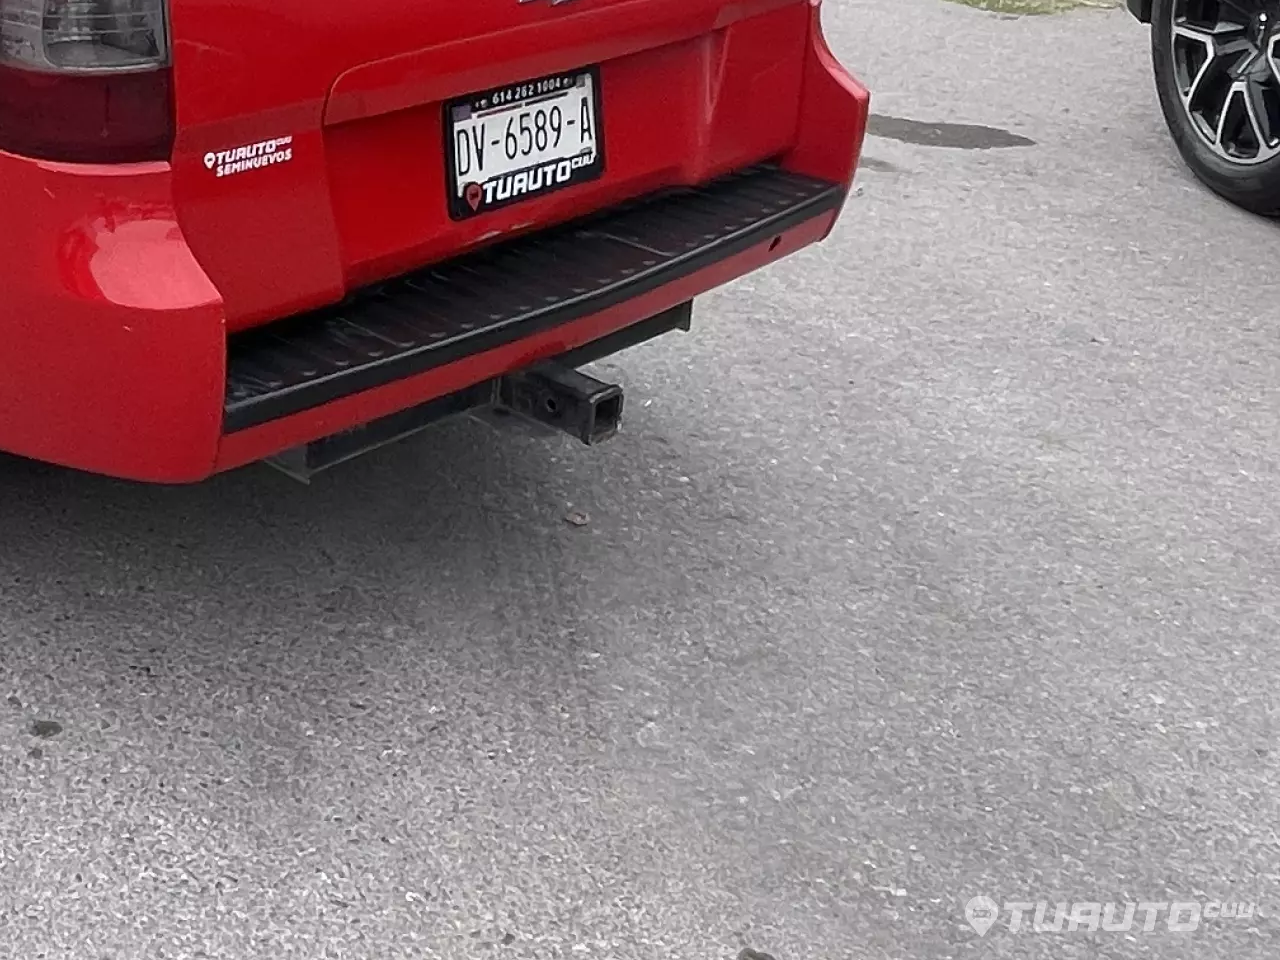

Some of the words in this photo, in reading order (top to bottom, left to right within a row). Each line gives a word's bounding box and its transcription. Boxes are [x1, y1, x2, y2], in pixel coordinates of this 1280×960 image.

[492, 89, 512, 105] 614
[537, 76, 561, 94] 1004
[456, 96, 593, 177] DV-6589-A
[216, 139, 277, 165] TUAUTO
[216, 147, 293, 177] SEMINUEVOS
[482, 161, 572, 204] TUAUTO
